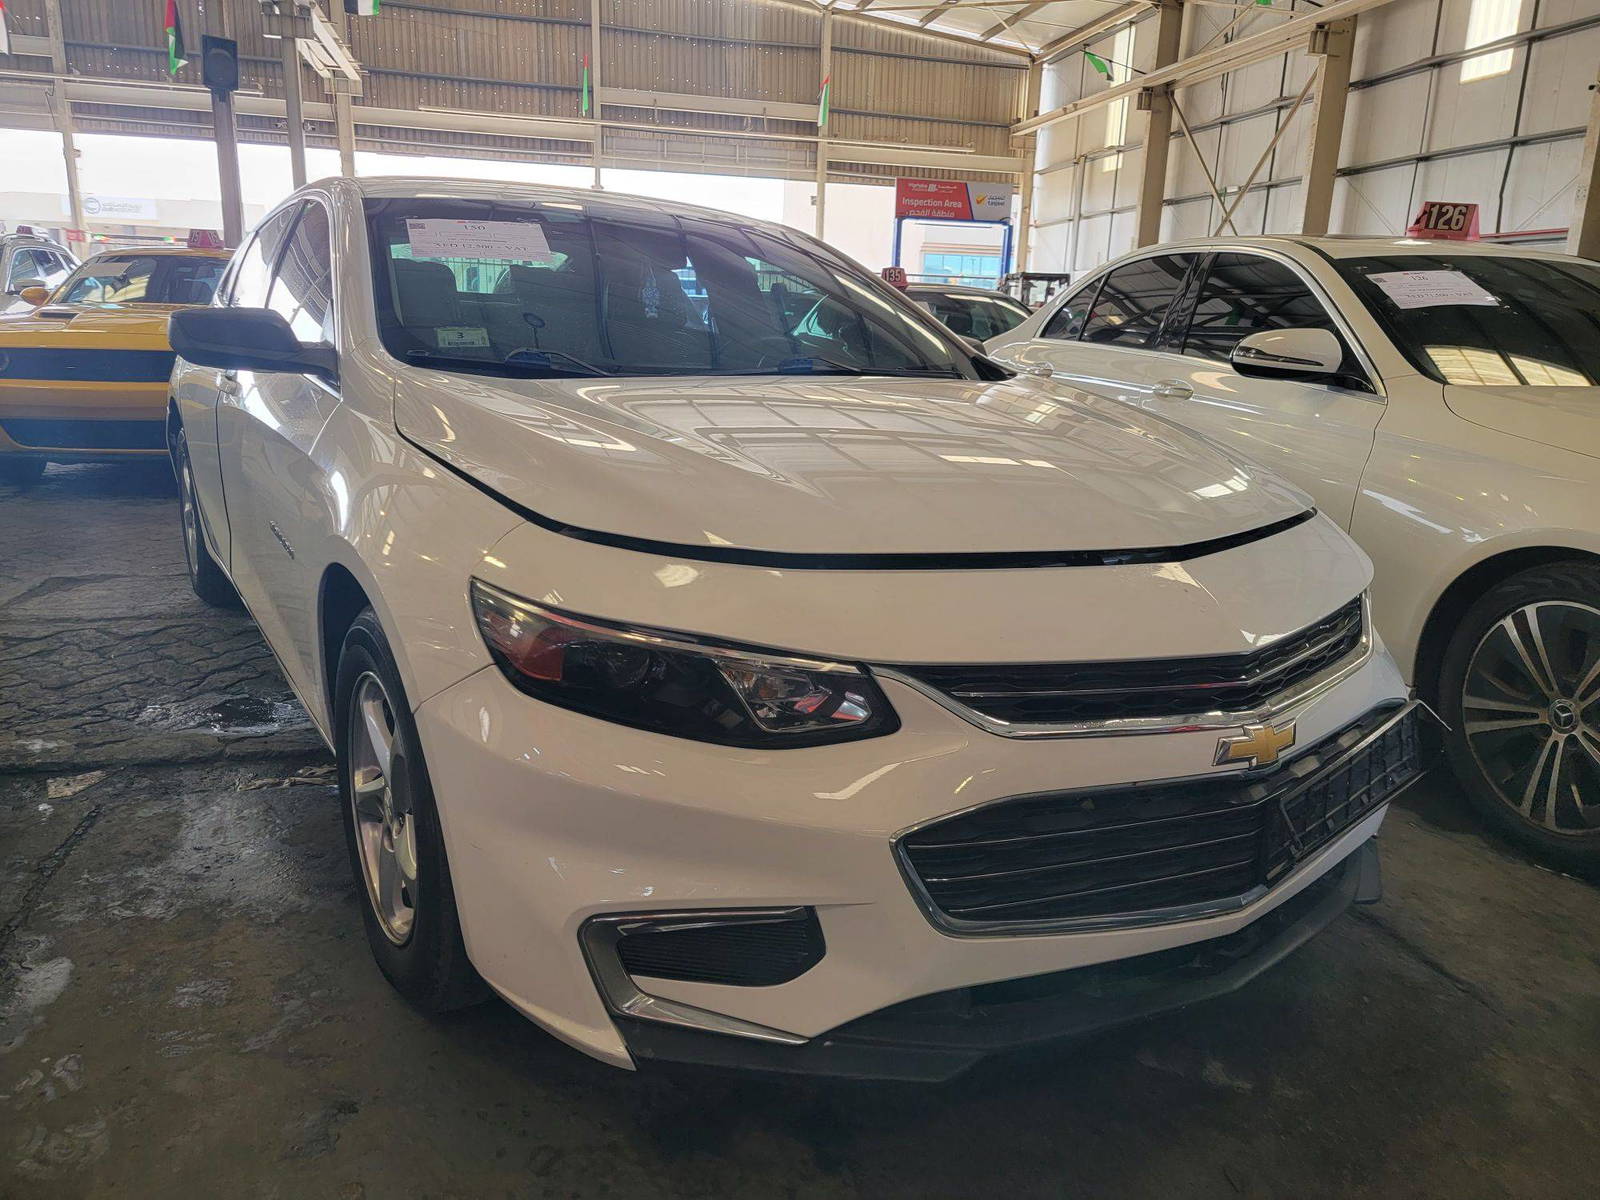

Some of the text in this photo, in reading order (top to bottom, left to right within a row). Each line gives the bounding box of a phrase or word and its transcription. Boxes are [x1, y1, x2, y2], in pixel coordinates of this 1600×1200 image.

[902, 197, 962, 208] Inspection Area
[1428, 204, 1467, 230] 126
[457, 331, 464, 339] 3
